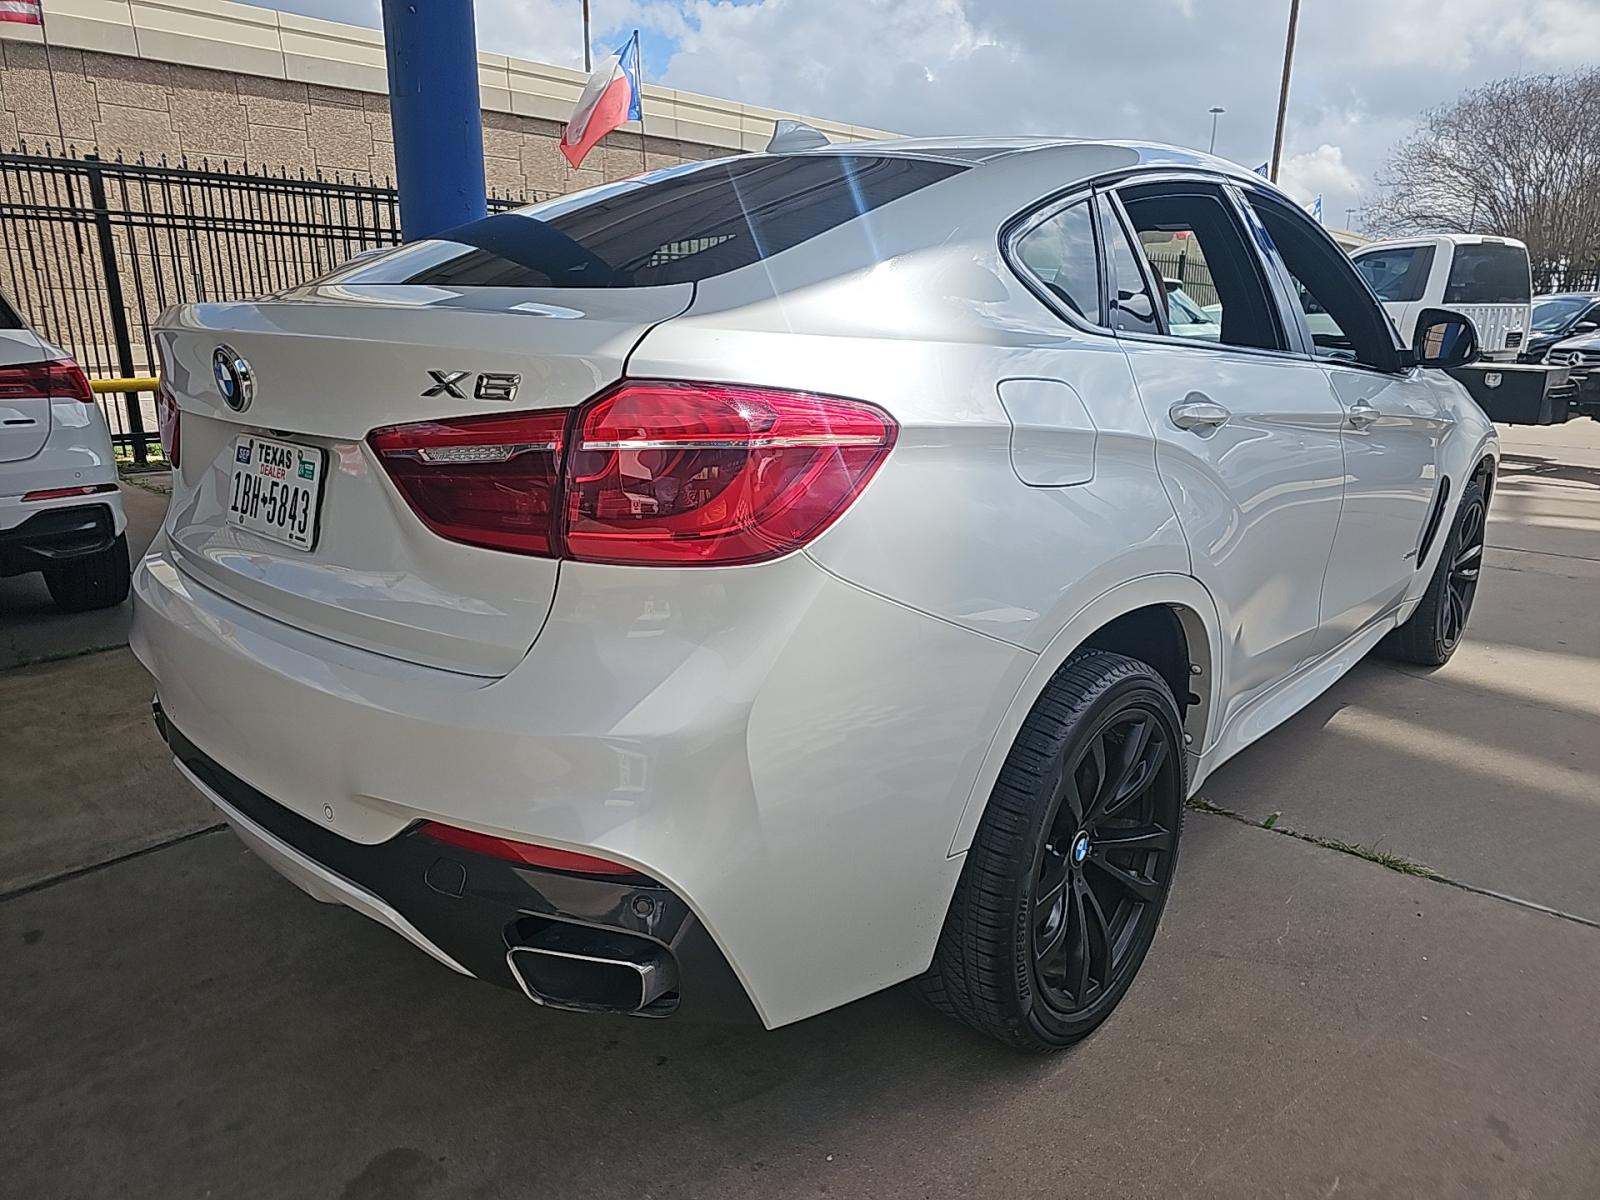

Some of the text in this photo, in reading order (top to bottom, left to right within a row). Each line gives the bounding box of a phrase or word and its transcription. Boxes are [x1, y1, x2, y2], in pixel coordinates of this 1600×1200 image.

[420, 371, 521, 401] X6
[258, 443, 292, 469] TEXAS
[260, 464, 286, 480] DEALER
